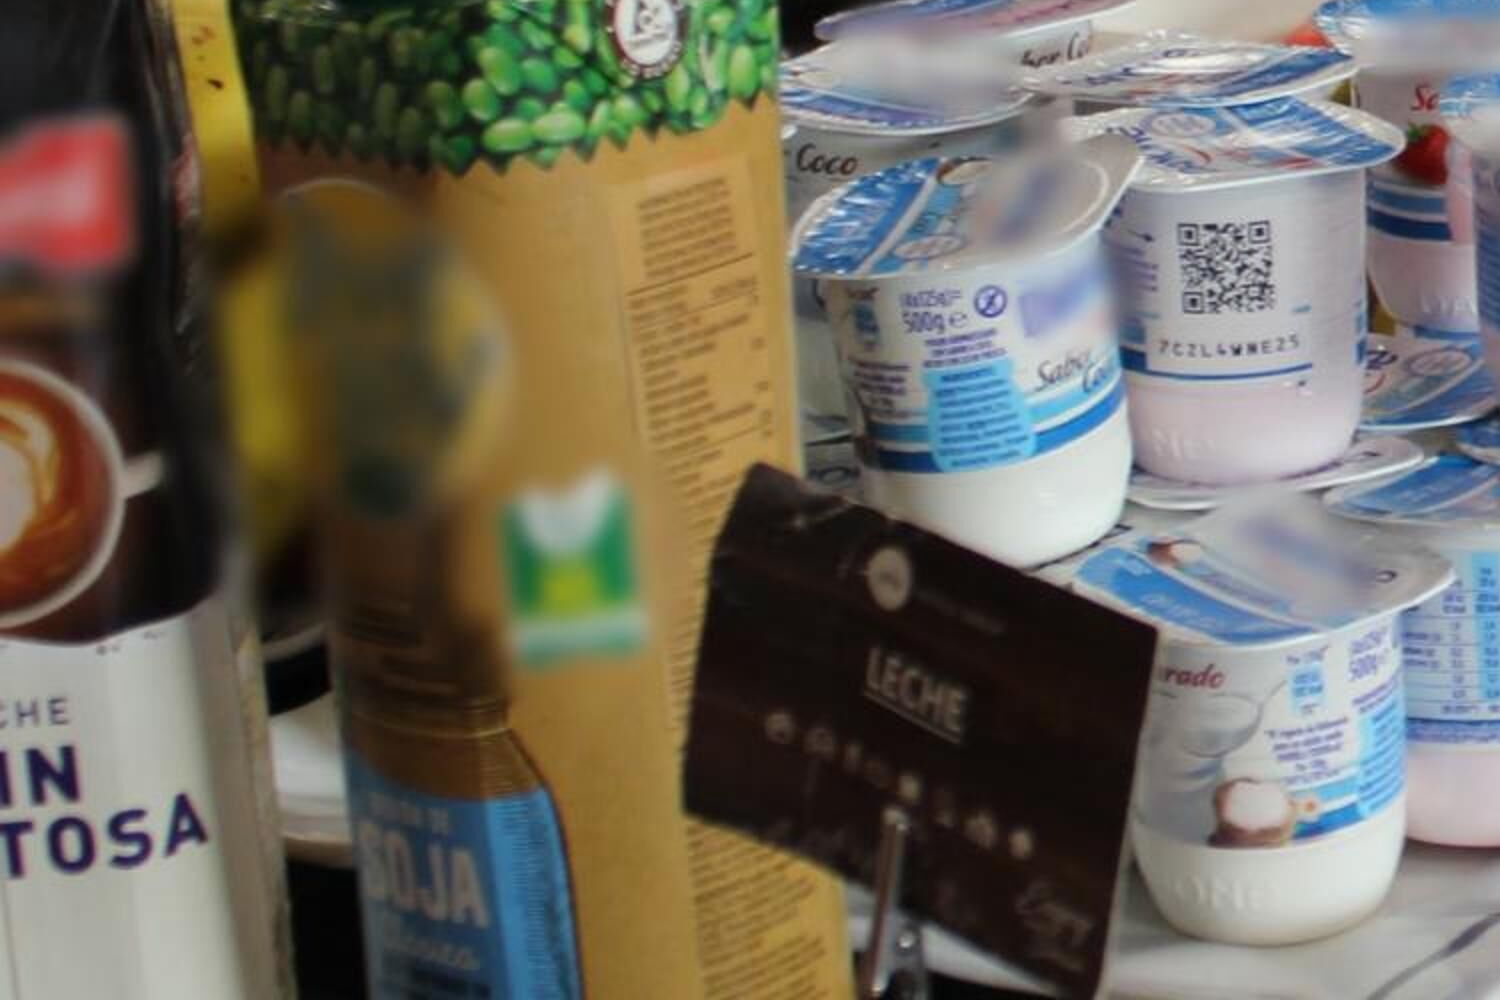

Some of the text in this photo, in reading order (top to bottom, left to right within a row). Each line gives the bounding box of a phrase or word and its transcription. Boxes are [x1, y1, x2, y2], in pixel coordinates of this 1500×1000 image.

[796, 143, 858, 176] Coco
[0, 697, 70, 729] HE
[864, 644, 969, 738] LECHE
[0, 792, 209, 881] TOSA
